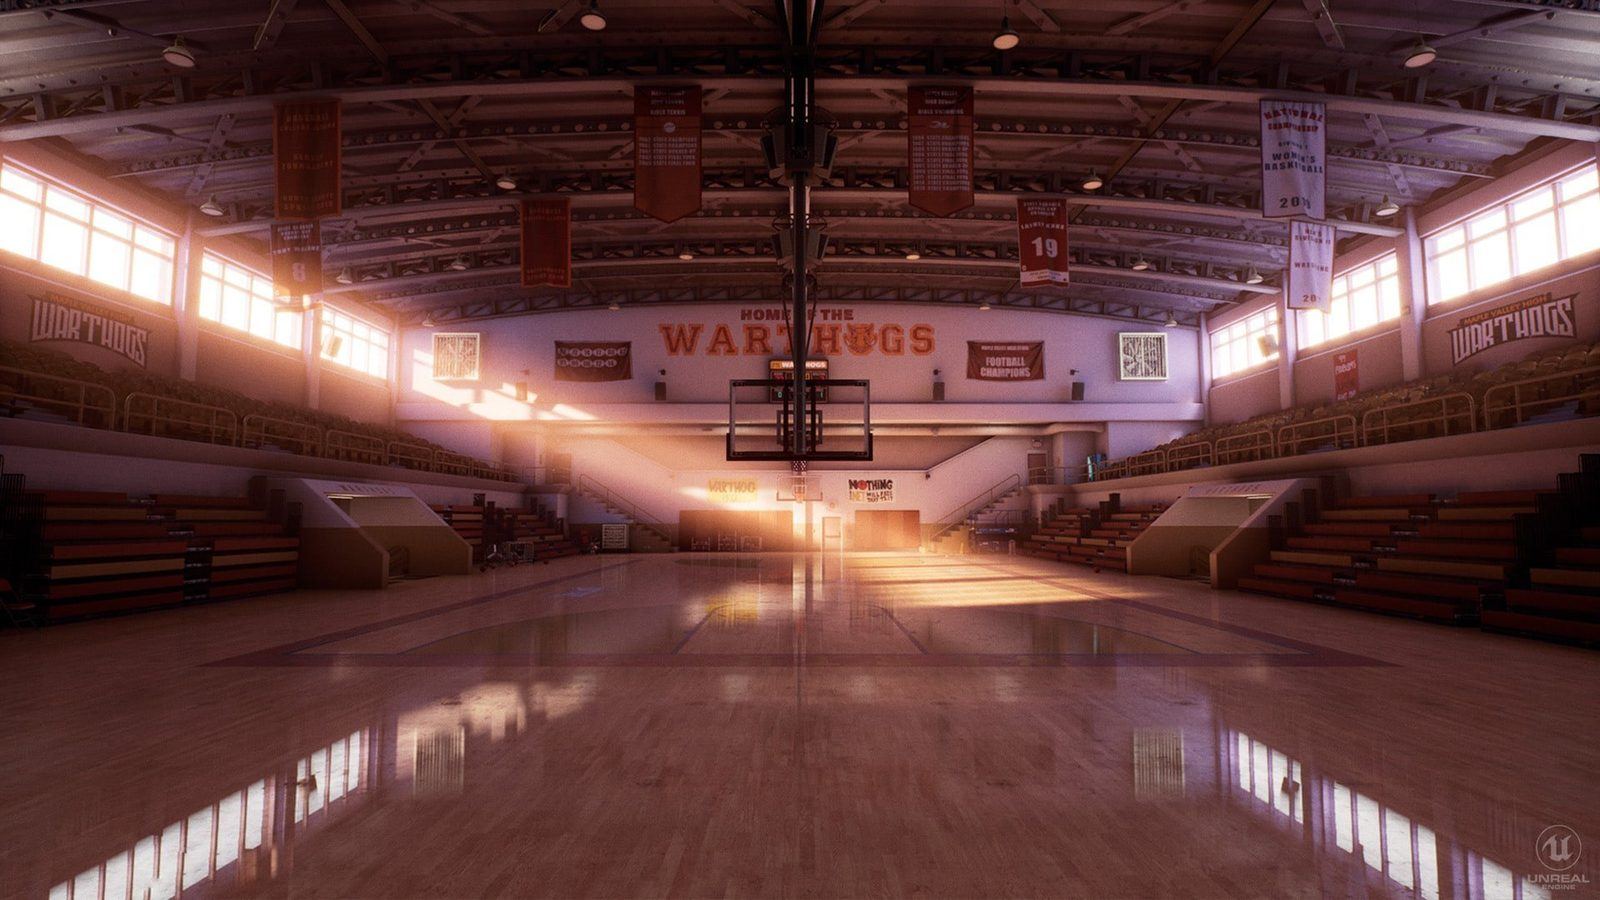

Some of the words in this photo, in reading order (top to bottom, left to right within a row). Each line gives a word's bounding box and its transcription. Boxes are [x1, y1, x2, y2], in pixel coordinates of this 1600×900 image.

[1031, 236, 1058, 258] 19
[741, 309, 791, 320] HOME
[820, 309, 855, 320] THE
[32, 300, 148, 368] WARTHOGS
[1453, 298, 1574, 364] WARTHOGS
[985, 356, 1025, 367] FOOTBALL
[980, 367, 1031, 378] CHAMPIONS
